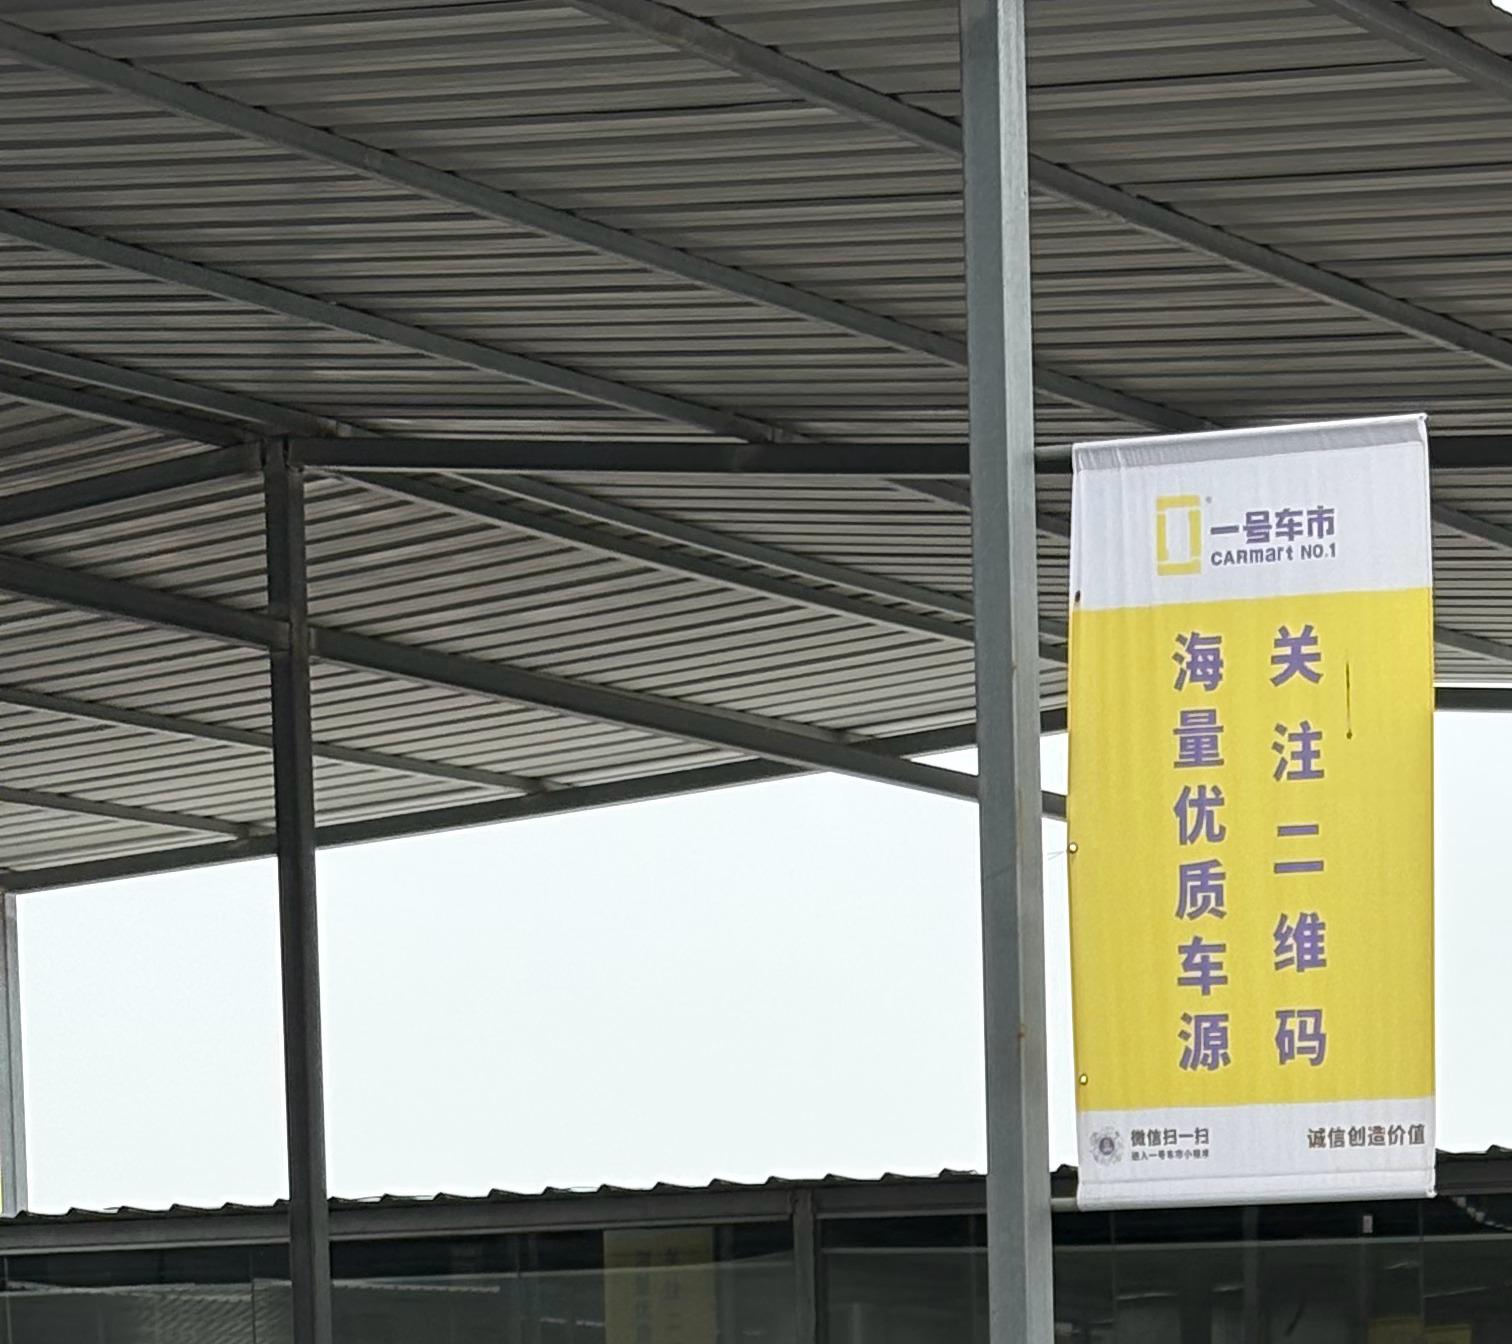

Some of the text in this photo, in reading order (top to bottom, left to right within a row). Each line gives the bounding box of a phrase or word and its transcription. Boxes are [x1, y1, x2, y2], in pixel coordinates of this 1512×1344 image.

[1210, 505, 1335, 544] 一号车市
[1210, 543, 1336, 566] CARmart NO.1
[1172, 632, 1231, 1071] 海量优质车源
[1270, 624, 1328, 1067] 关注二维码
[1131, 1127, 1209, 1147] 微信扫一扫
[1307, 1124, 1426, 1149] 诚信创造价值
